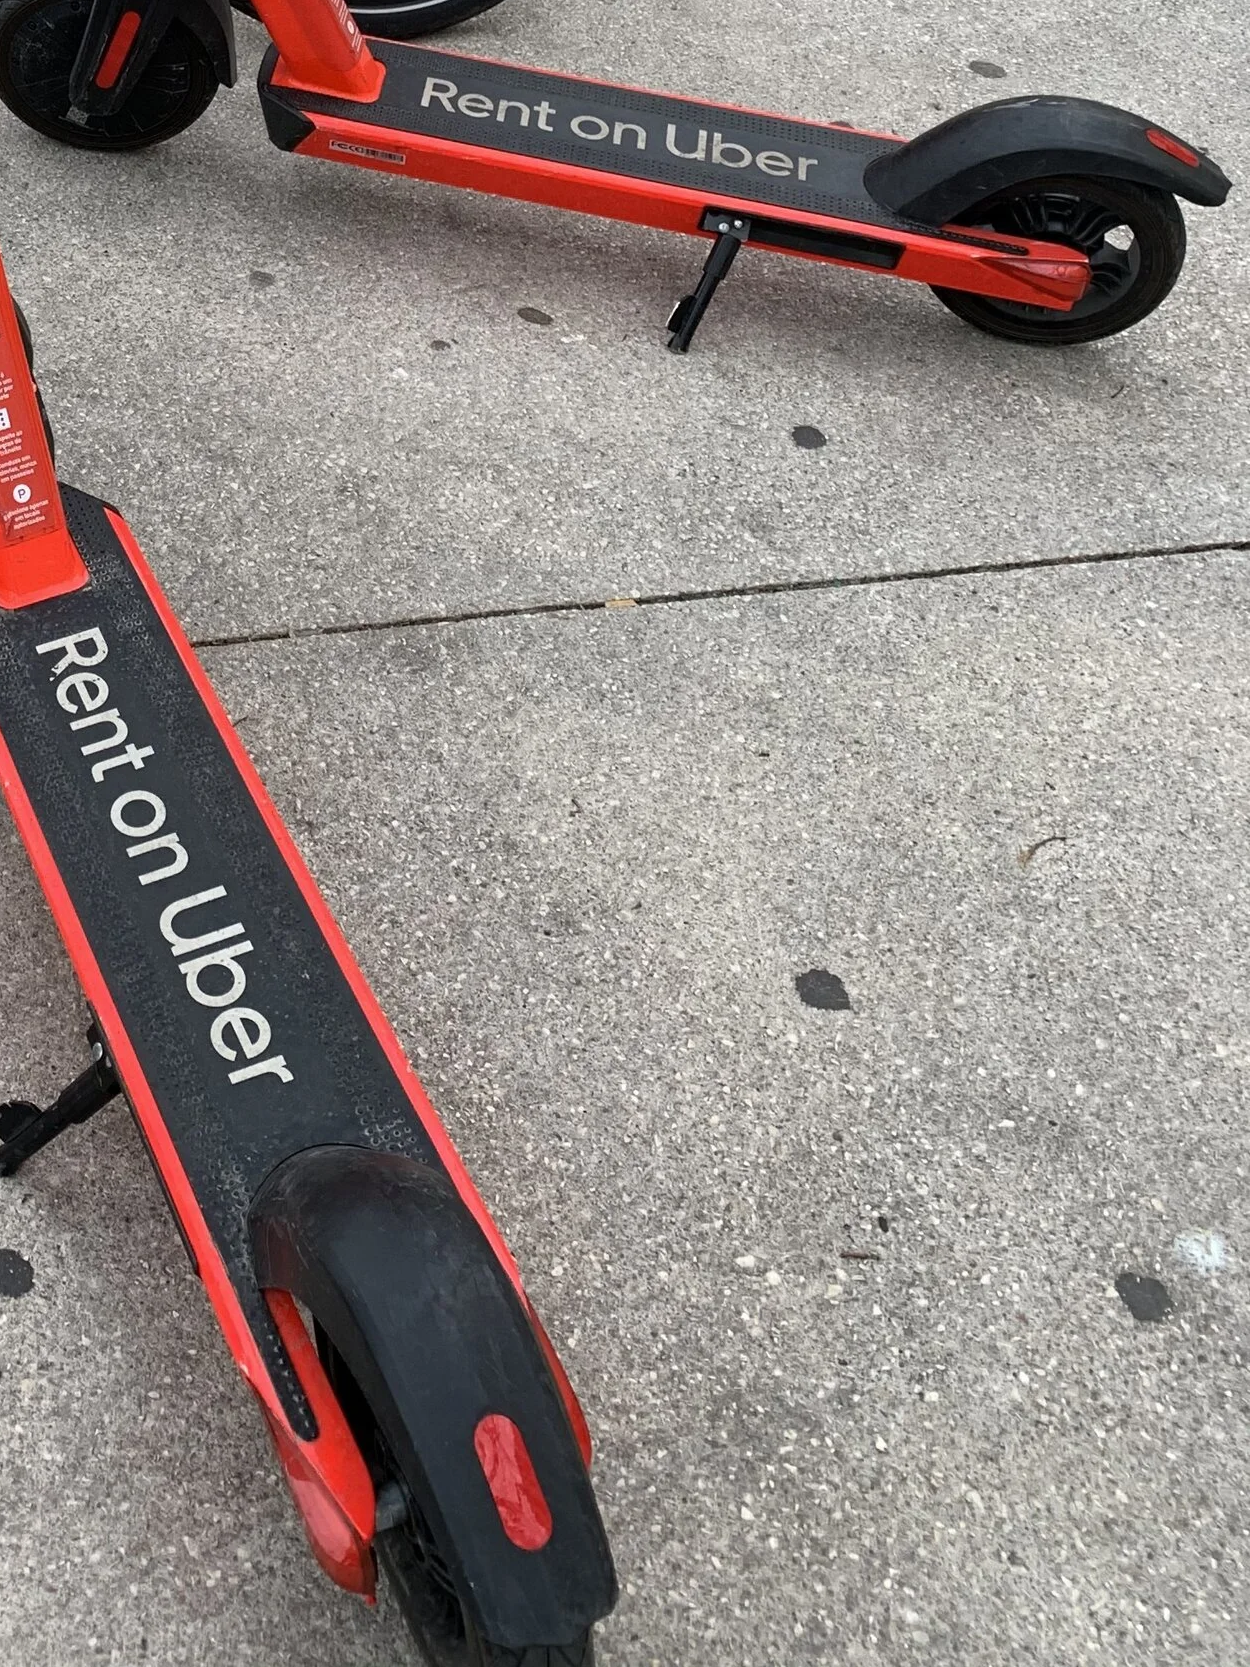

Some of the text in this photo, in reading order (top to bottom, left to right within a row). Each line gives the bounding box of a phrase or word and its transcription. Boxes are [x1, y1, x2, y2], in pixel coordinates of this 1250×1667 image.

[420, 76, 819, 182] Rent on Uber
[35, 626, 295, 1085] Rent on Uber
